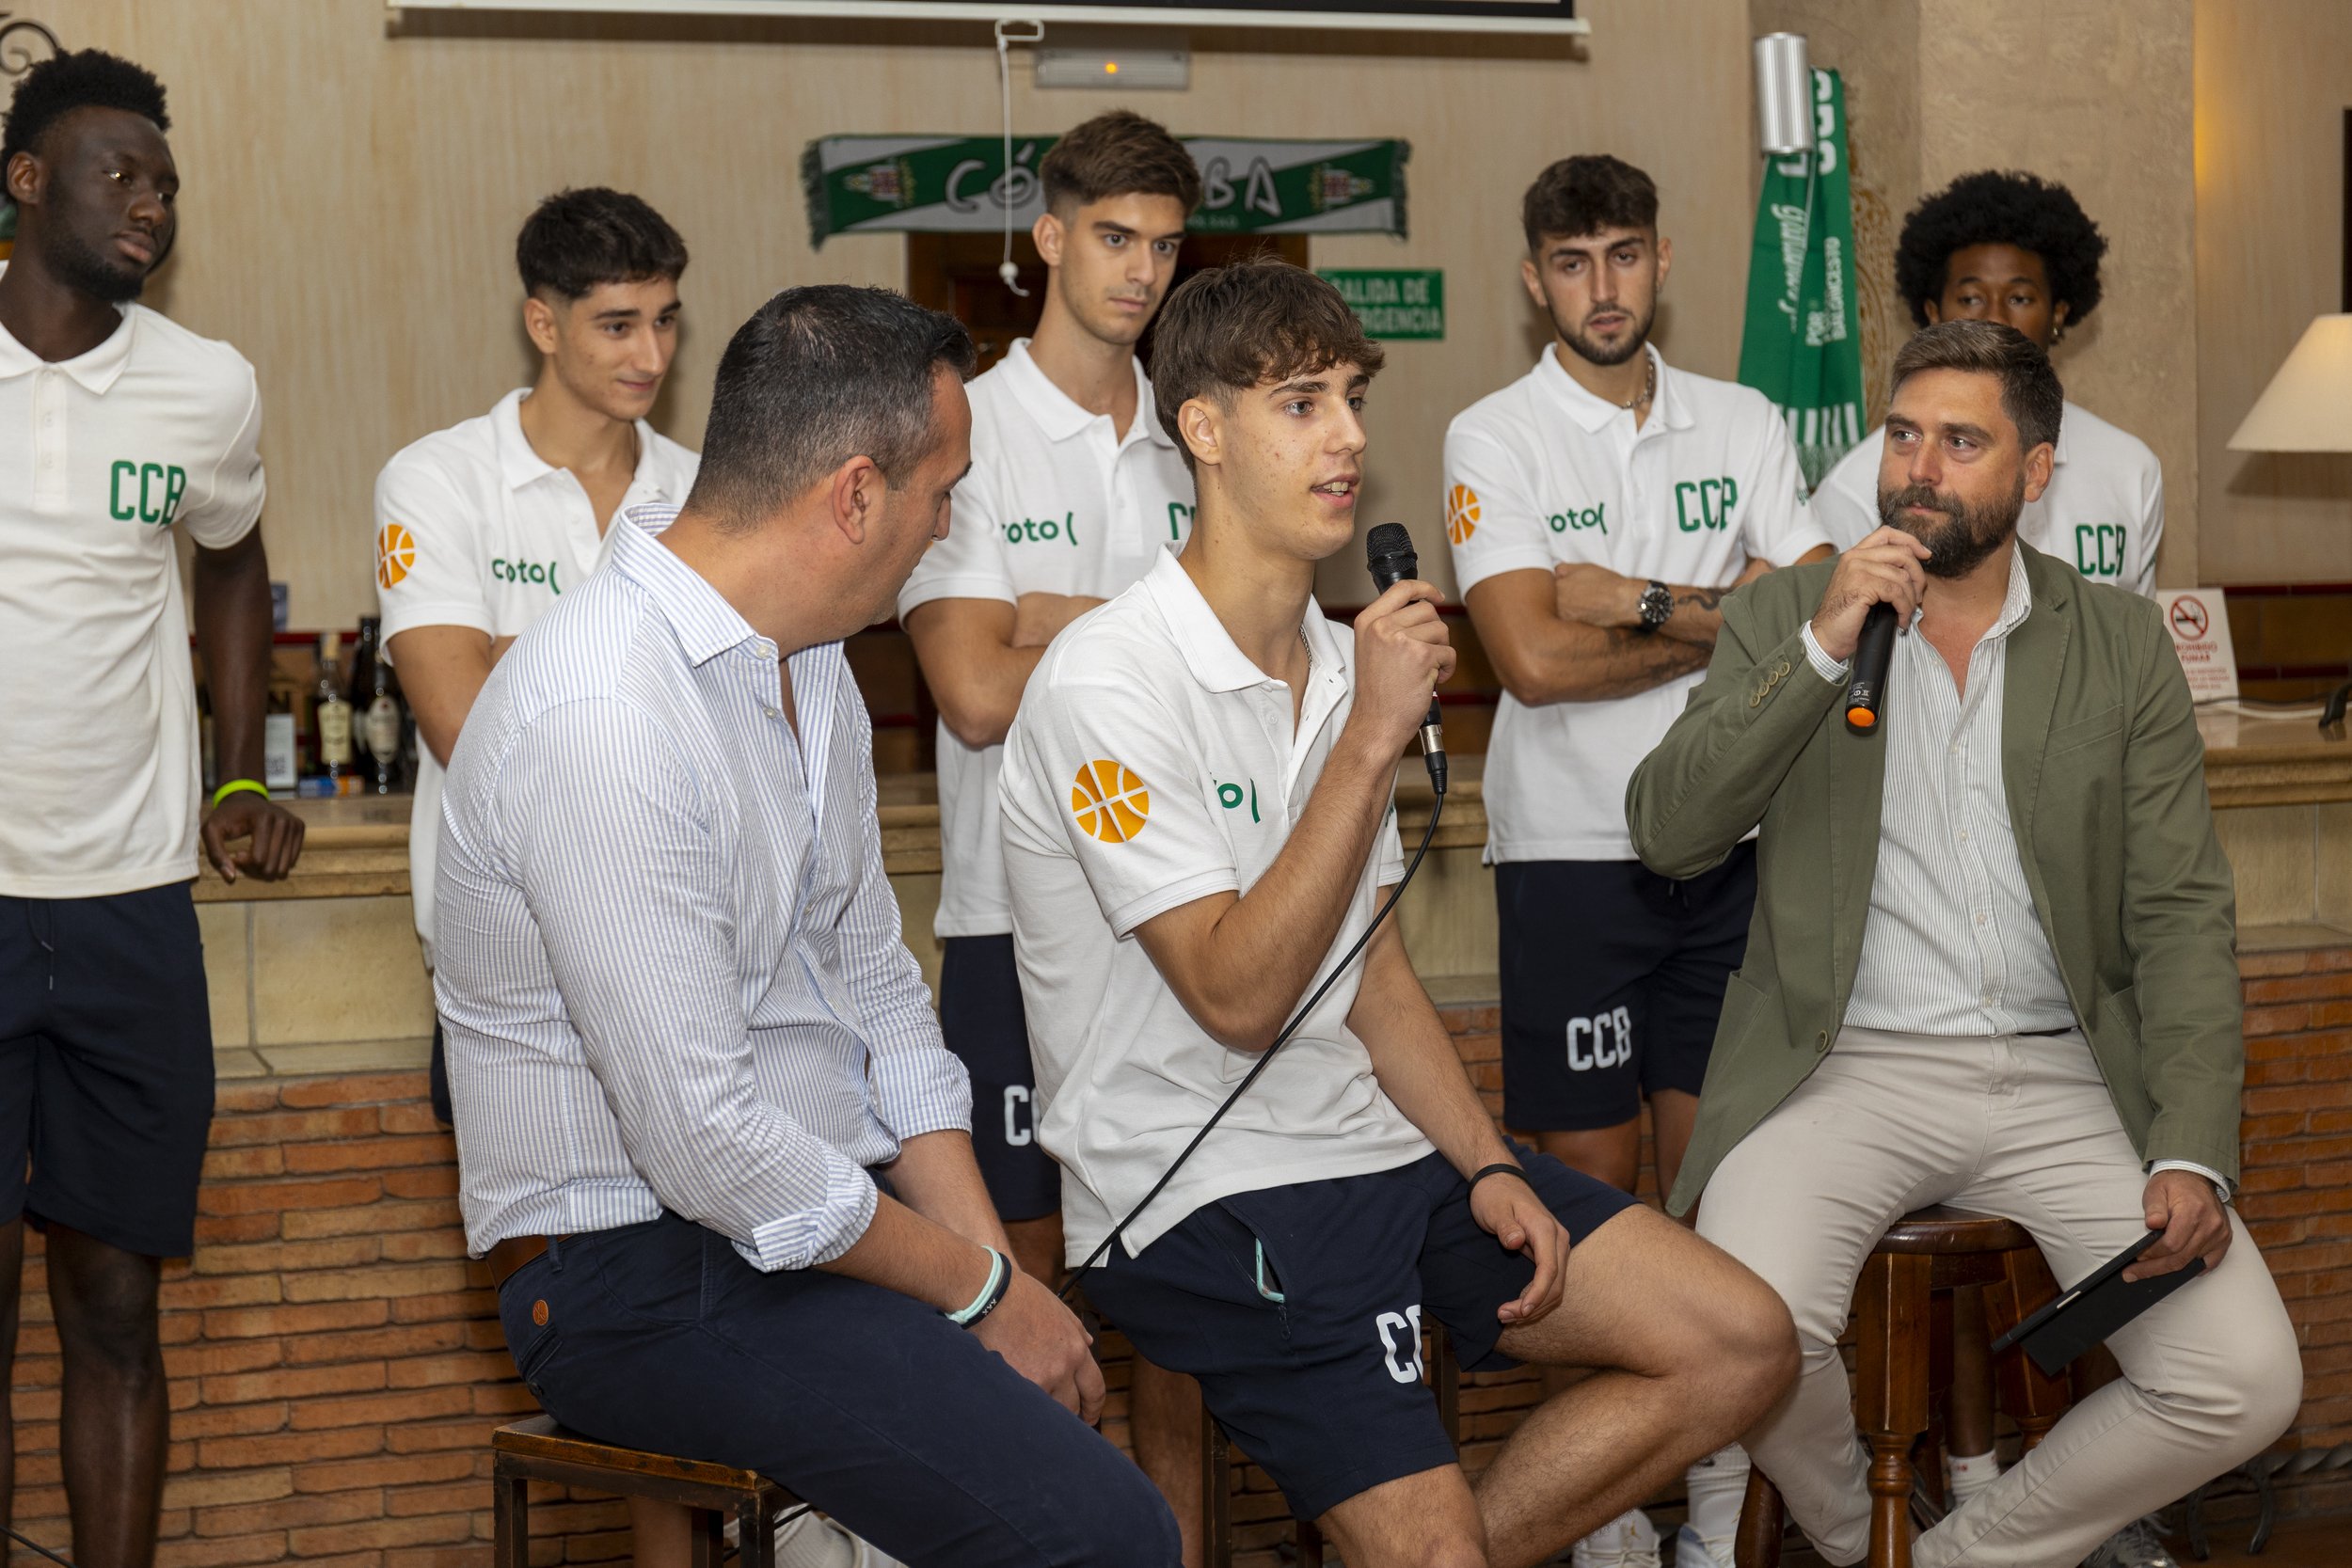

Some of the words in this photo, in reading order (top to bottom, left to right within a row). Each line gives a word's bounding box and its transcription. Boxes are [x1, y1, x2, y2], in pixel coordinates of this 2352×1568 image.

[946, 141, 1282, 217] CÓBA
[1403, 277, 1430, 304] DE
[109, 459, 187, 526] CCB
[2075, 524, 2126, 577] CCB
[1566, 1006, 1632, 1071] CCB
